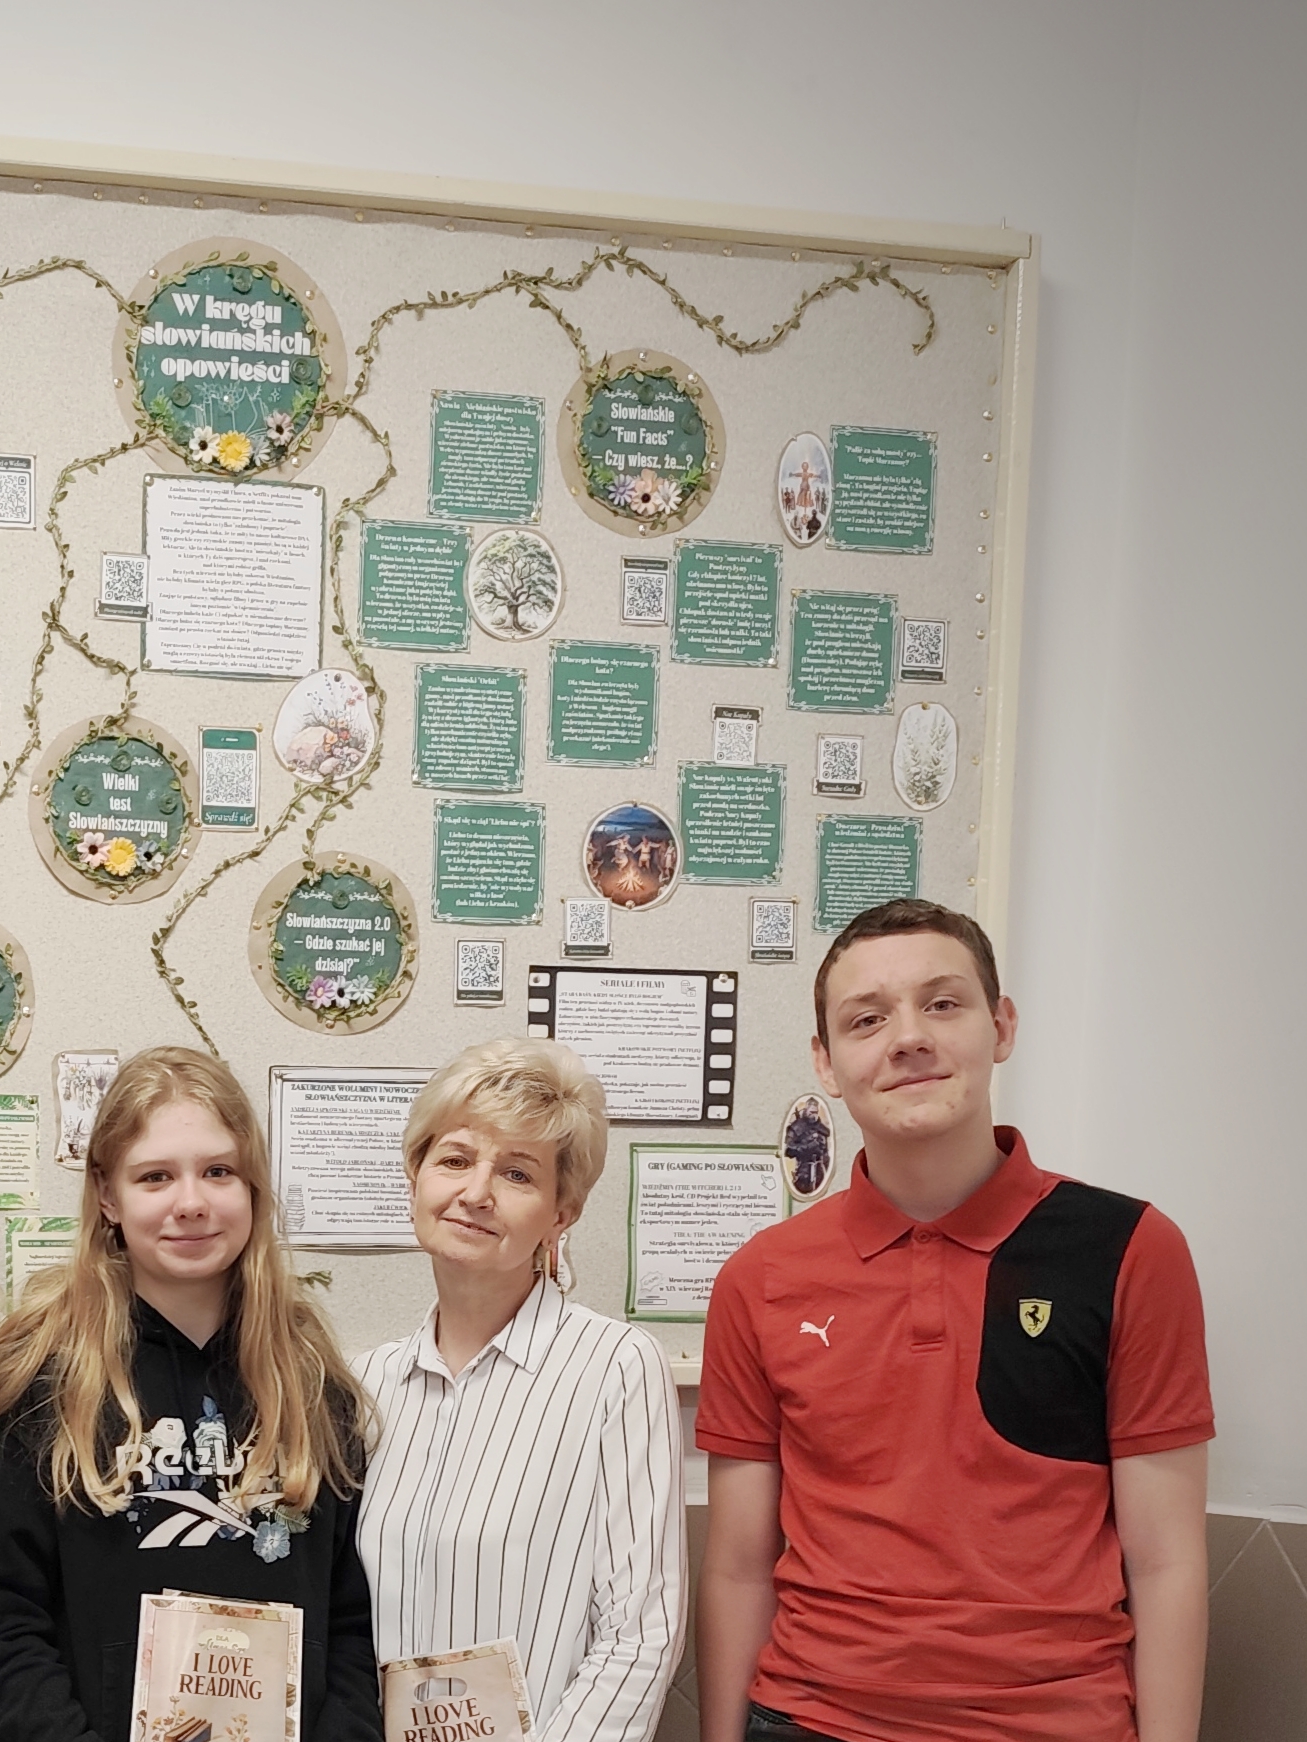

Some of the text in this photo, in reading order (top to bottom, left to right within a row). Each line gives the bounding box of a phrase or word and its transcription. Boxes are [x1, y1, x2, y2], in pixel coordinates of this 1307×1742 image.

[171, 293, 281, 329] W kręgu
[161, 356, 290, 384] opowieści
[605, 449, 625, 471] Czy
[102, 773, 139, 791] Wielki
[109, 796, 131, 811] test
[374, 916, 390, 931] 2.0
[306, 935, 333, 950] Gdzie
[336, 937, 370, 951] szukać
[372, 938, 385, 956] jej
[648, 1162, 665, 1170] GRY
[667, 1162, 703, 1171] (GAMING
[717, 1163, 774, 1172] SŁOWIAŃSKU)
[193, 1653, 254, 1677] I LOVE
[179, 1674, 262, 1700] READING
[410, 1698, 480, 1726] I LOVE
